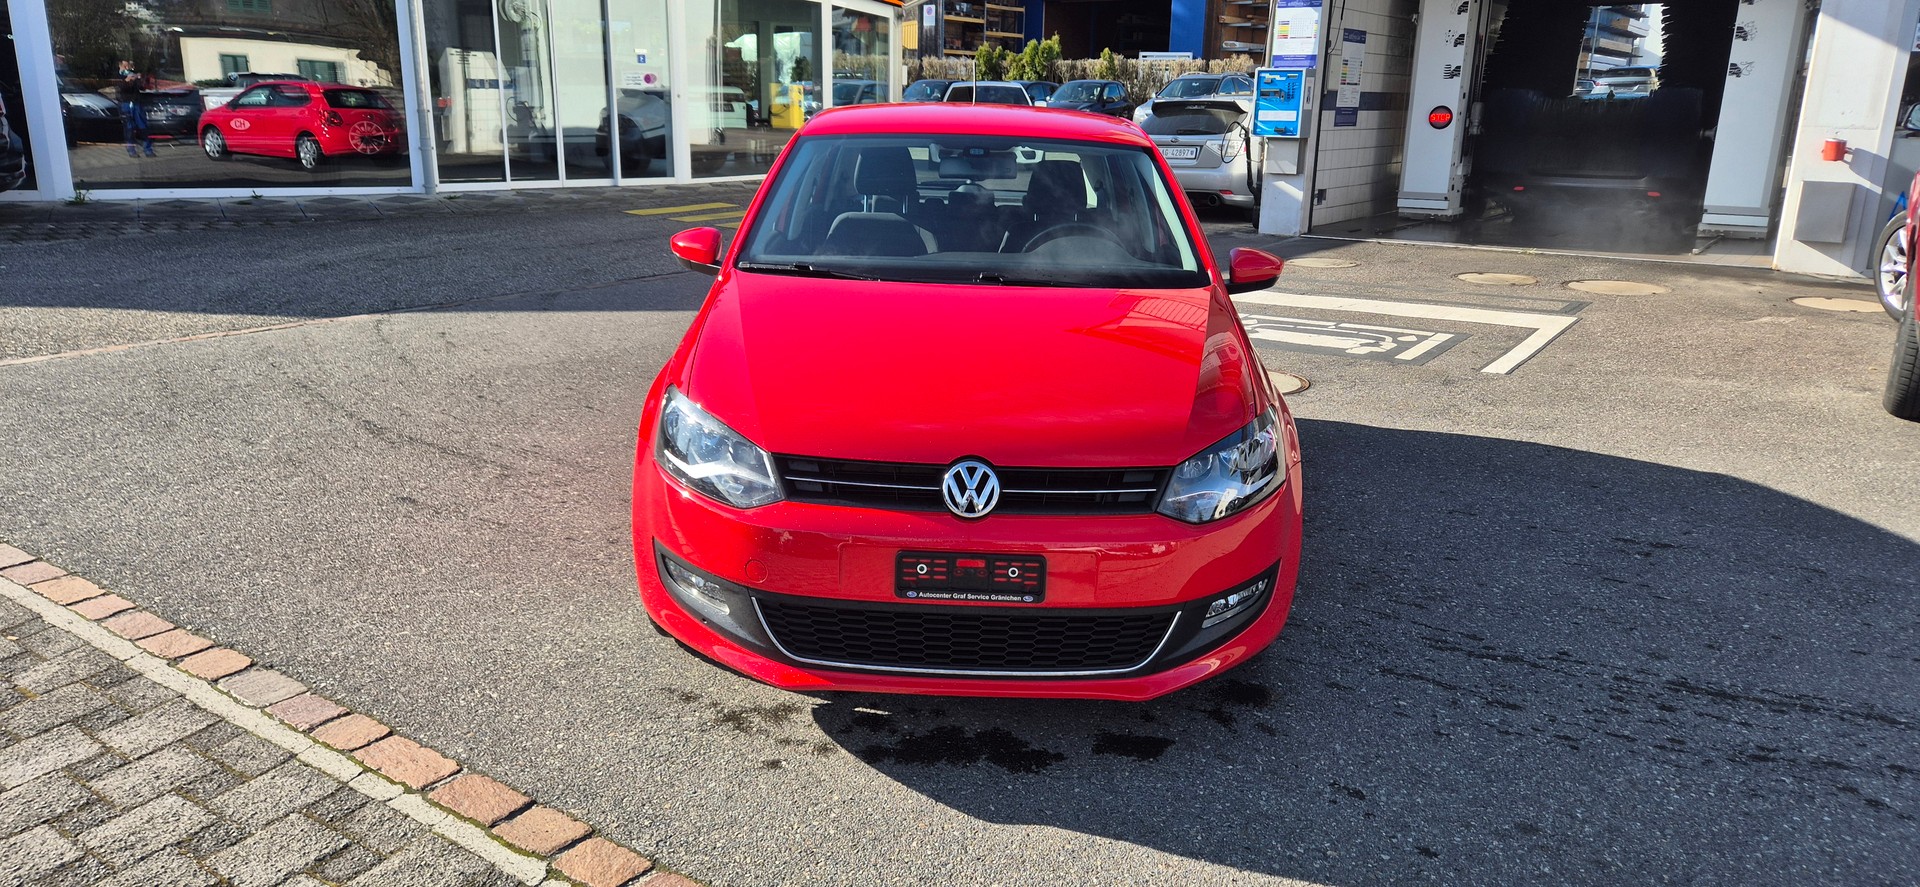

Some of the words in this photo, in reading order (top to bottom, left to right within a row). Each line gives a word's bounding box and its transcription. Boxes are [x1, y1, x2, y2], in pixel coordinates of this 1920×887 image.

[1430, 113, 1451, 121] STOP
[234, 119, 246, 129] CH
[943, 461, 1000, 518] VW
[919, 591, 952, 599] Autocenter
[952, 592, 967, 600] Graf
[967, 593, 990, 601] Service
[990, 594, 1021, 602] Gränichen
